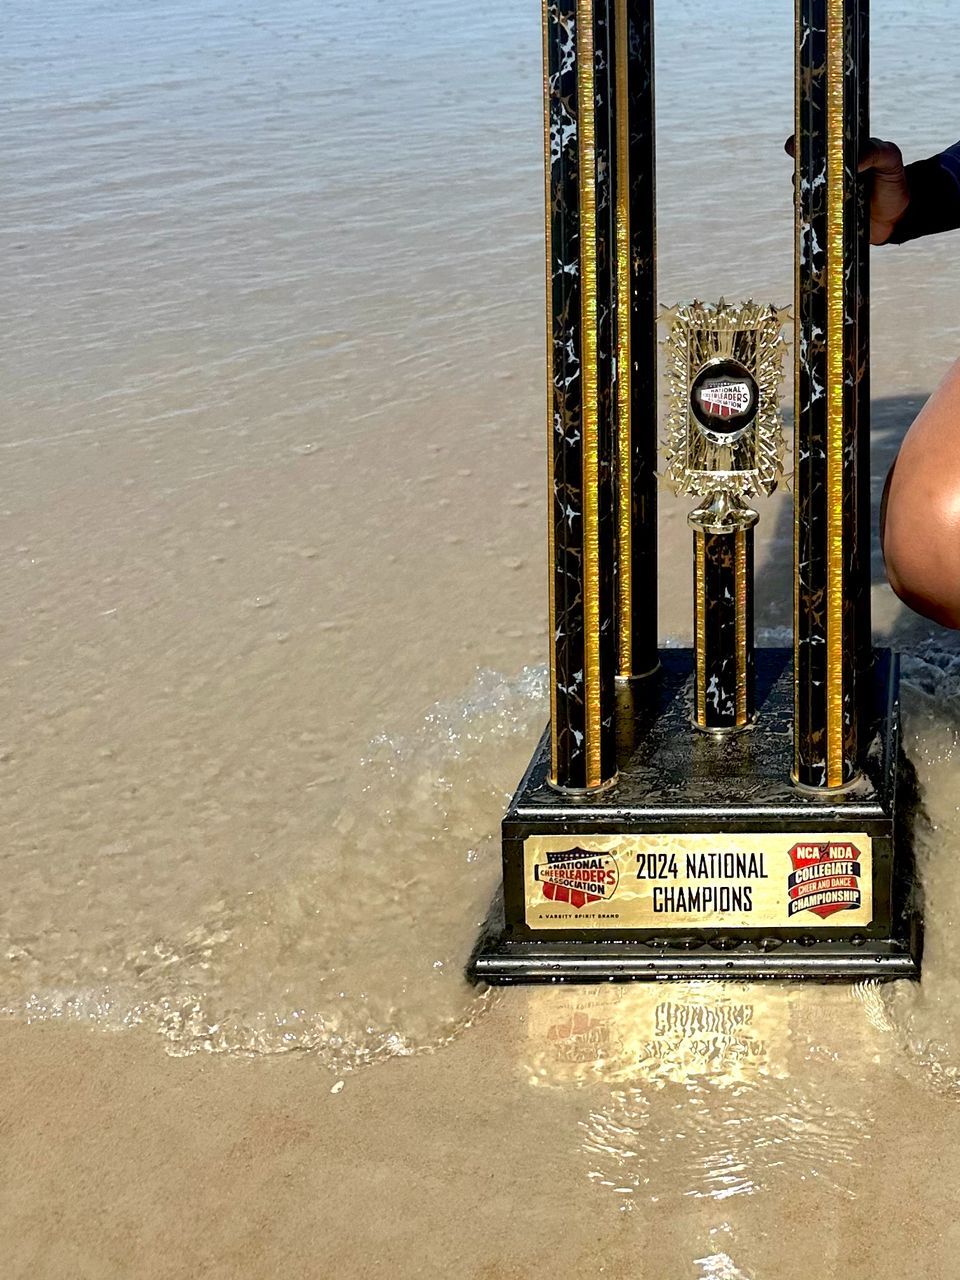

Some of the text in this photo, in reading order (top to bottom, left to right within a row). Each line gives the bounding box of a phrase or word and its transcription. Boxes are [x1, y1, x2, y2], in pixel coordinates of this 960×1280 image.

[796, 846, 853, 859] NCA NDA
[553, 858, 605, 870] NATIONAL
[636, 852, 769, 880] 2024 NATIONAL
[795, 862, 854, 884] COLLEGIATE
[540, 869, 616, 885] CHEERLEADERS
[548, 877, 605, 895] ASSOCIATION
[653, 886, 753, 912] CHAMPIONS
[791, 890, 859, 913] CHAMPIONSHIP
